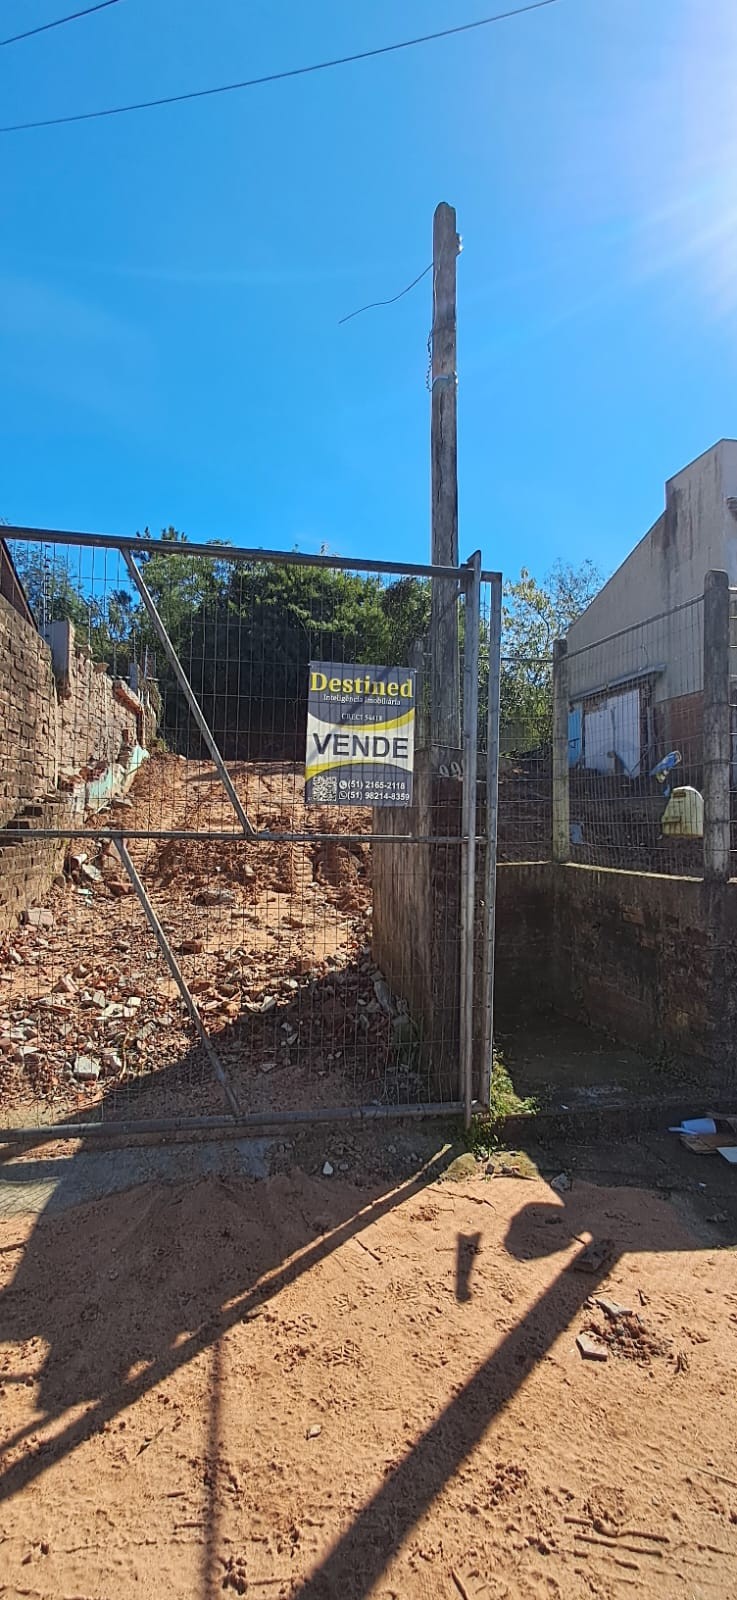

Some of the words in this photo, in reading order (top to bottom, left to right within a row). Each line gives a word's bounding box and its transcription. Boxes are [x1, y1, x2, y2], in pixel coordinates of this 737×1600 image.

[310, 672, 413, 698] Destined
[313, 732, 409, 759] VENDE
[347, 779, 363, 790] (51)
[365, 780, 406, 790] 2165-2118
[347, 790, 363, 801] (51)
